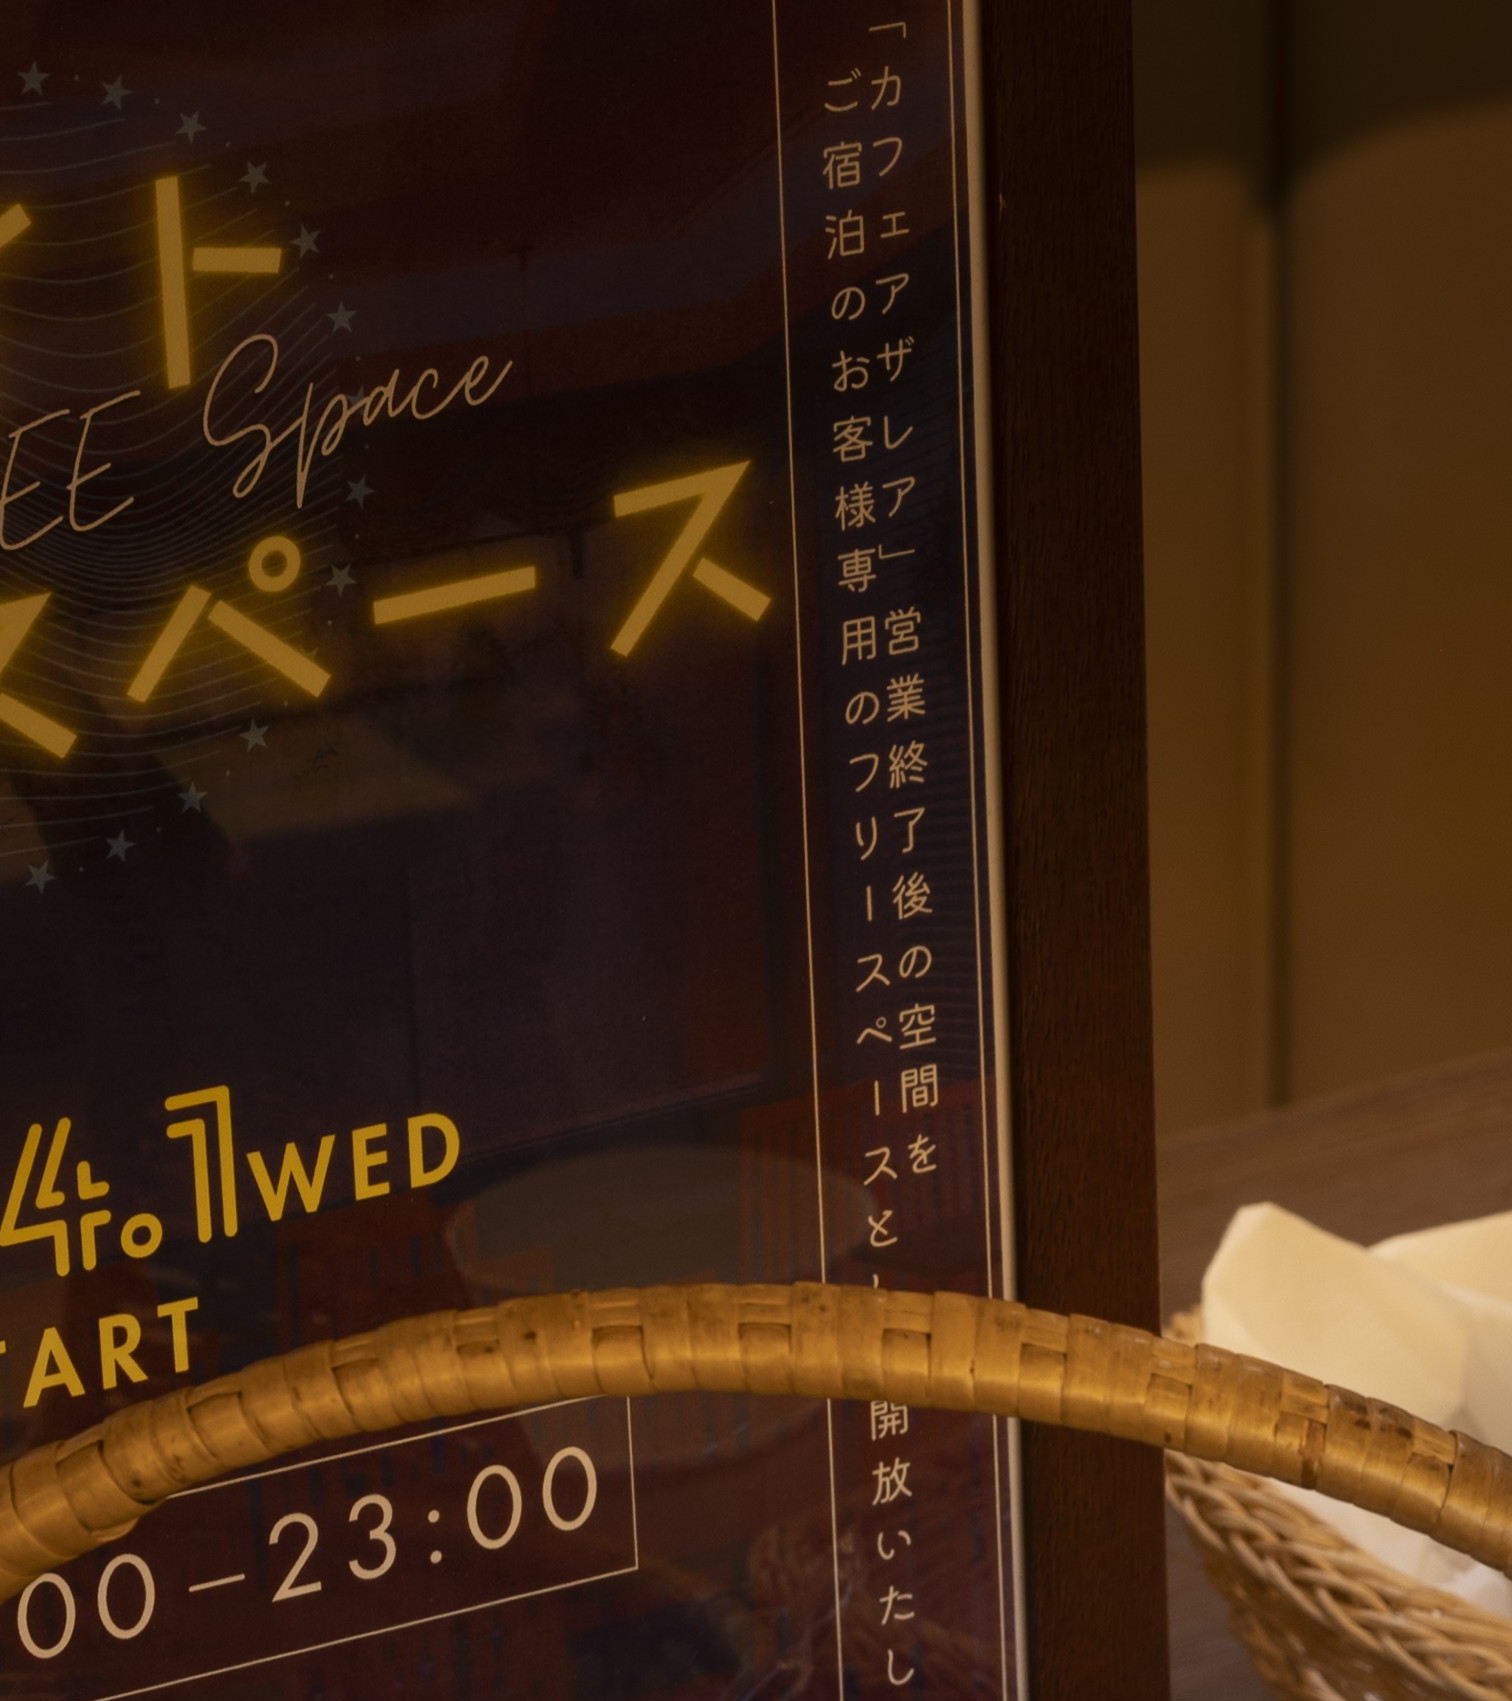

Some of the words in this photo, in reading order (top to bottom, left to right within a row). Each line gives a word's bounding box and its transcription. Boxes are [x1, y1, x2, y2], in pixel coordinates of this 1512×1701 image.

[200, 333, 514, 509] Space
[866, 18, 938, 1176] 「カフェアザレア」営業終了後の空間を
[244, 1110, 464, 1215] WED
